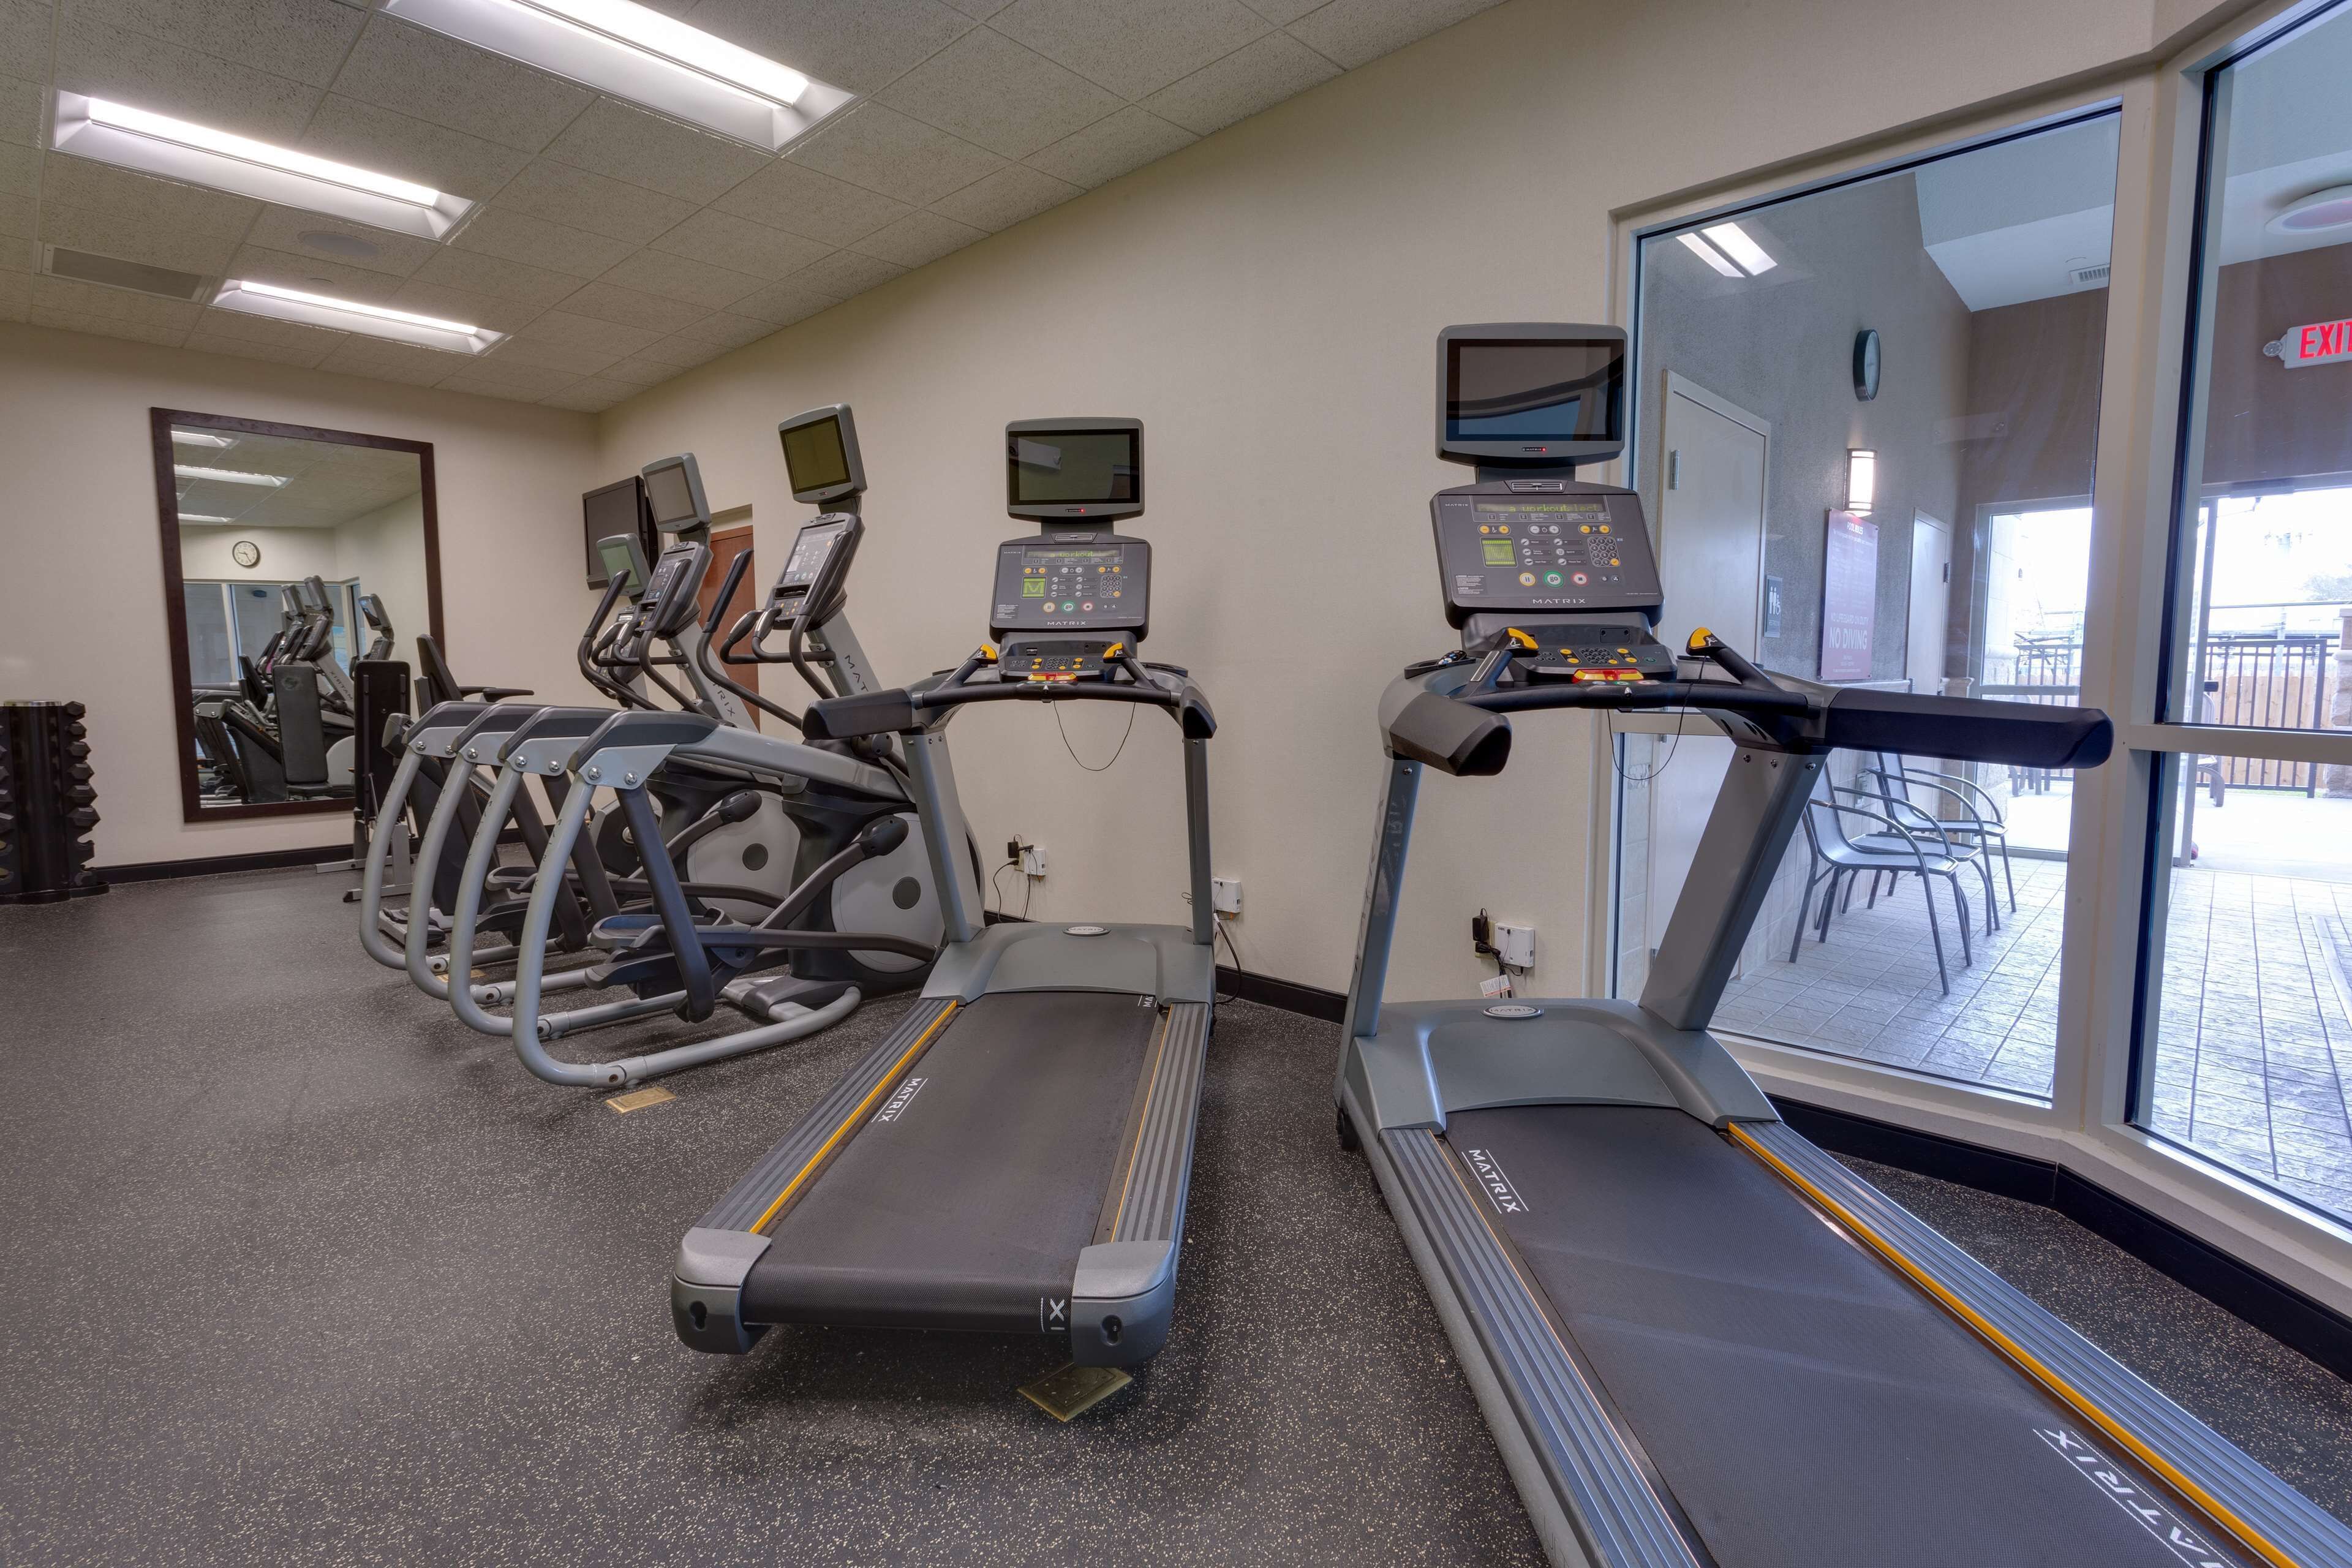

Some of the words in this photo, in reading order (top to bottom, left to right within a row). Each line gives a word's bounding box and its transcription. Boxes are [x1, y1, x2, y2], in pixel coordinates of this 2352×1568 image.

[1829, 627, 1841, 649] NO
[1842, 628, 1868, 650] DIVING
[878, 1078, 922, 1122] MATRIX
[1468, 1149, 1521, 1213] MATRIX
